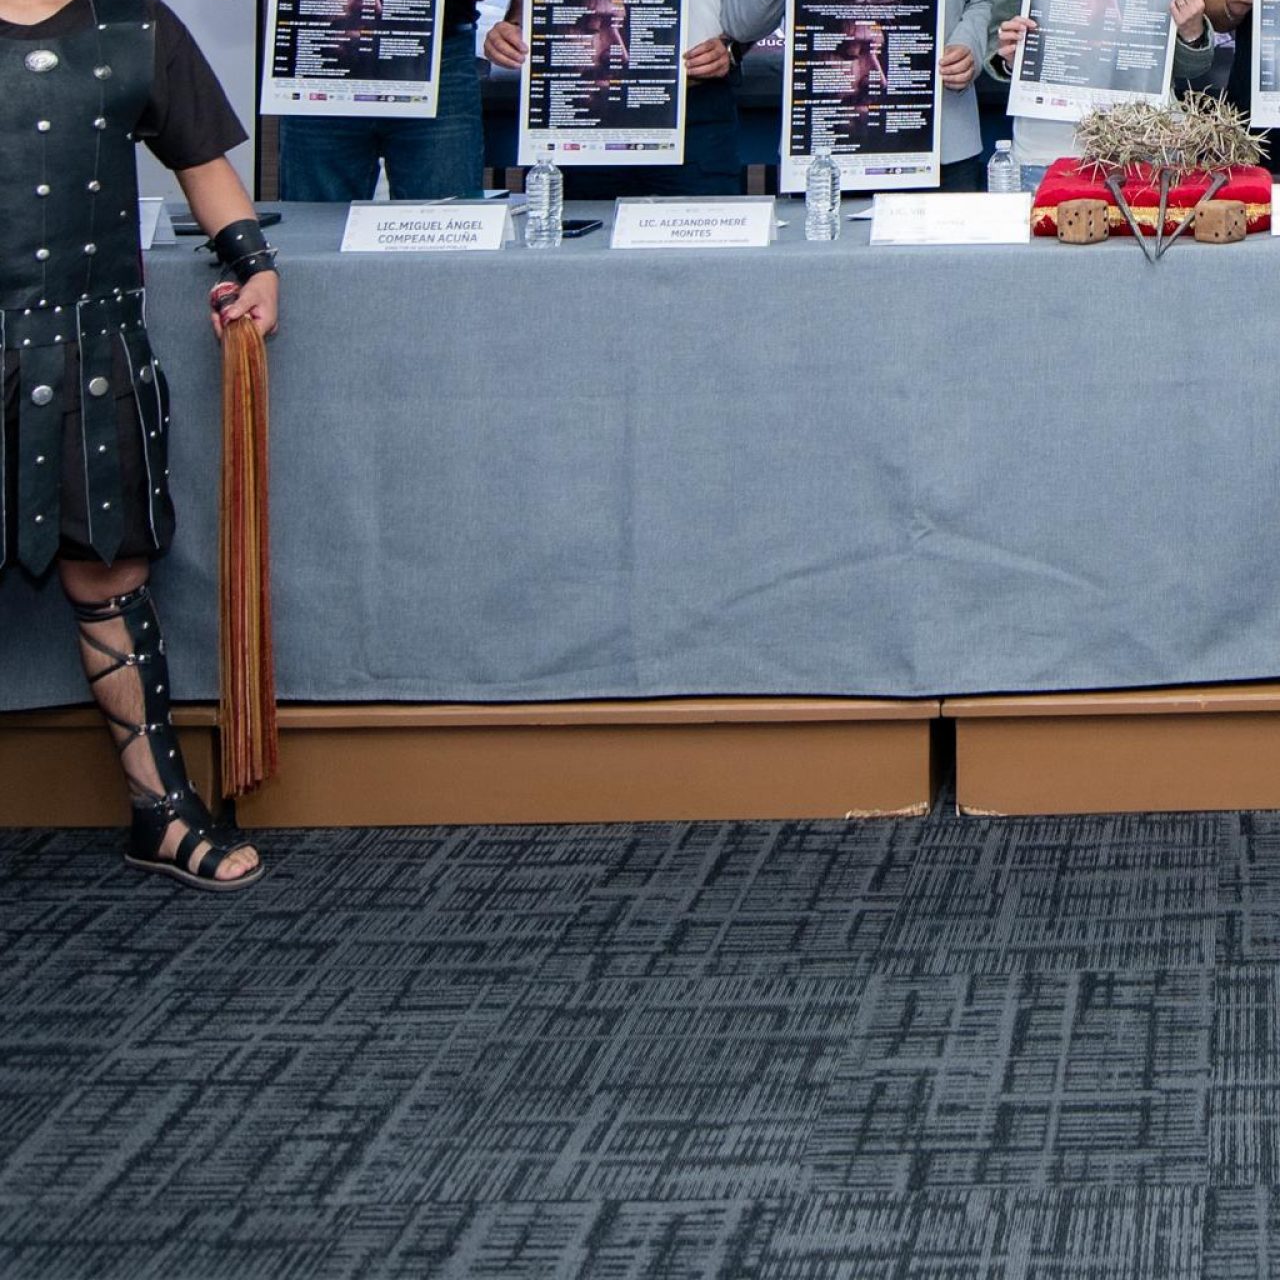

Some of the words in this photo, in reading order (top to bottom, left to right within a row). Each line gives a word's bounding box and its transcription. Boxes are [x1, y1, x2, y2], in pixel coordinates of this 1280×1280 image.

[445, 219, 483, 231] ÁNGEL
[639, 219, 657, 228] LIC.
[659, 219, 718, 227] ALEJANDRO
[720, 217, 748, 226] MERÉ
[378, 234, 436, 244] COMPEAN
[438, 232, 478, 243] ACUÑA
[670, 229, 712, 238] MONTES
